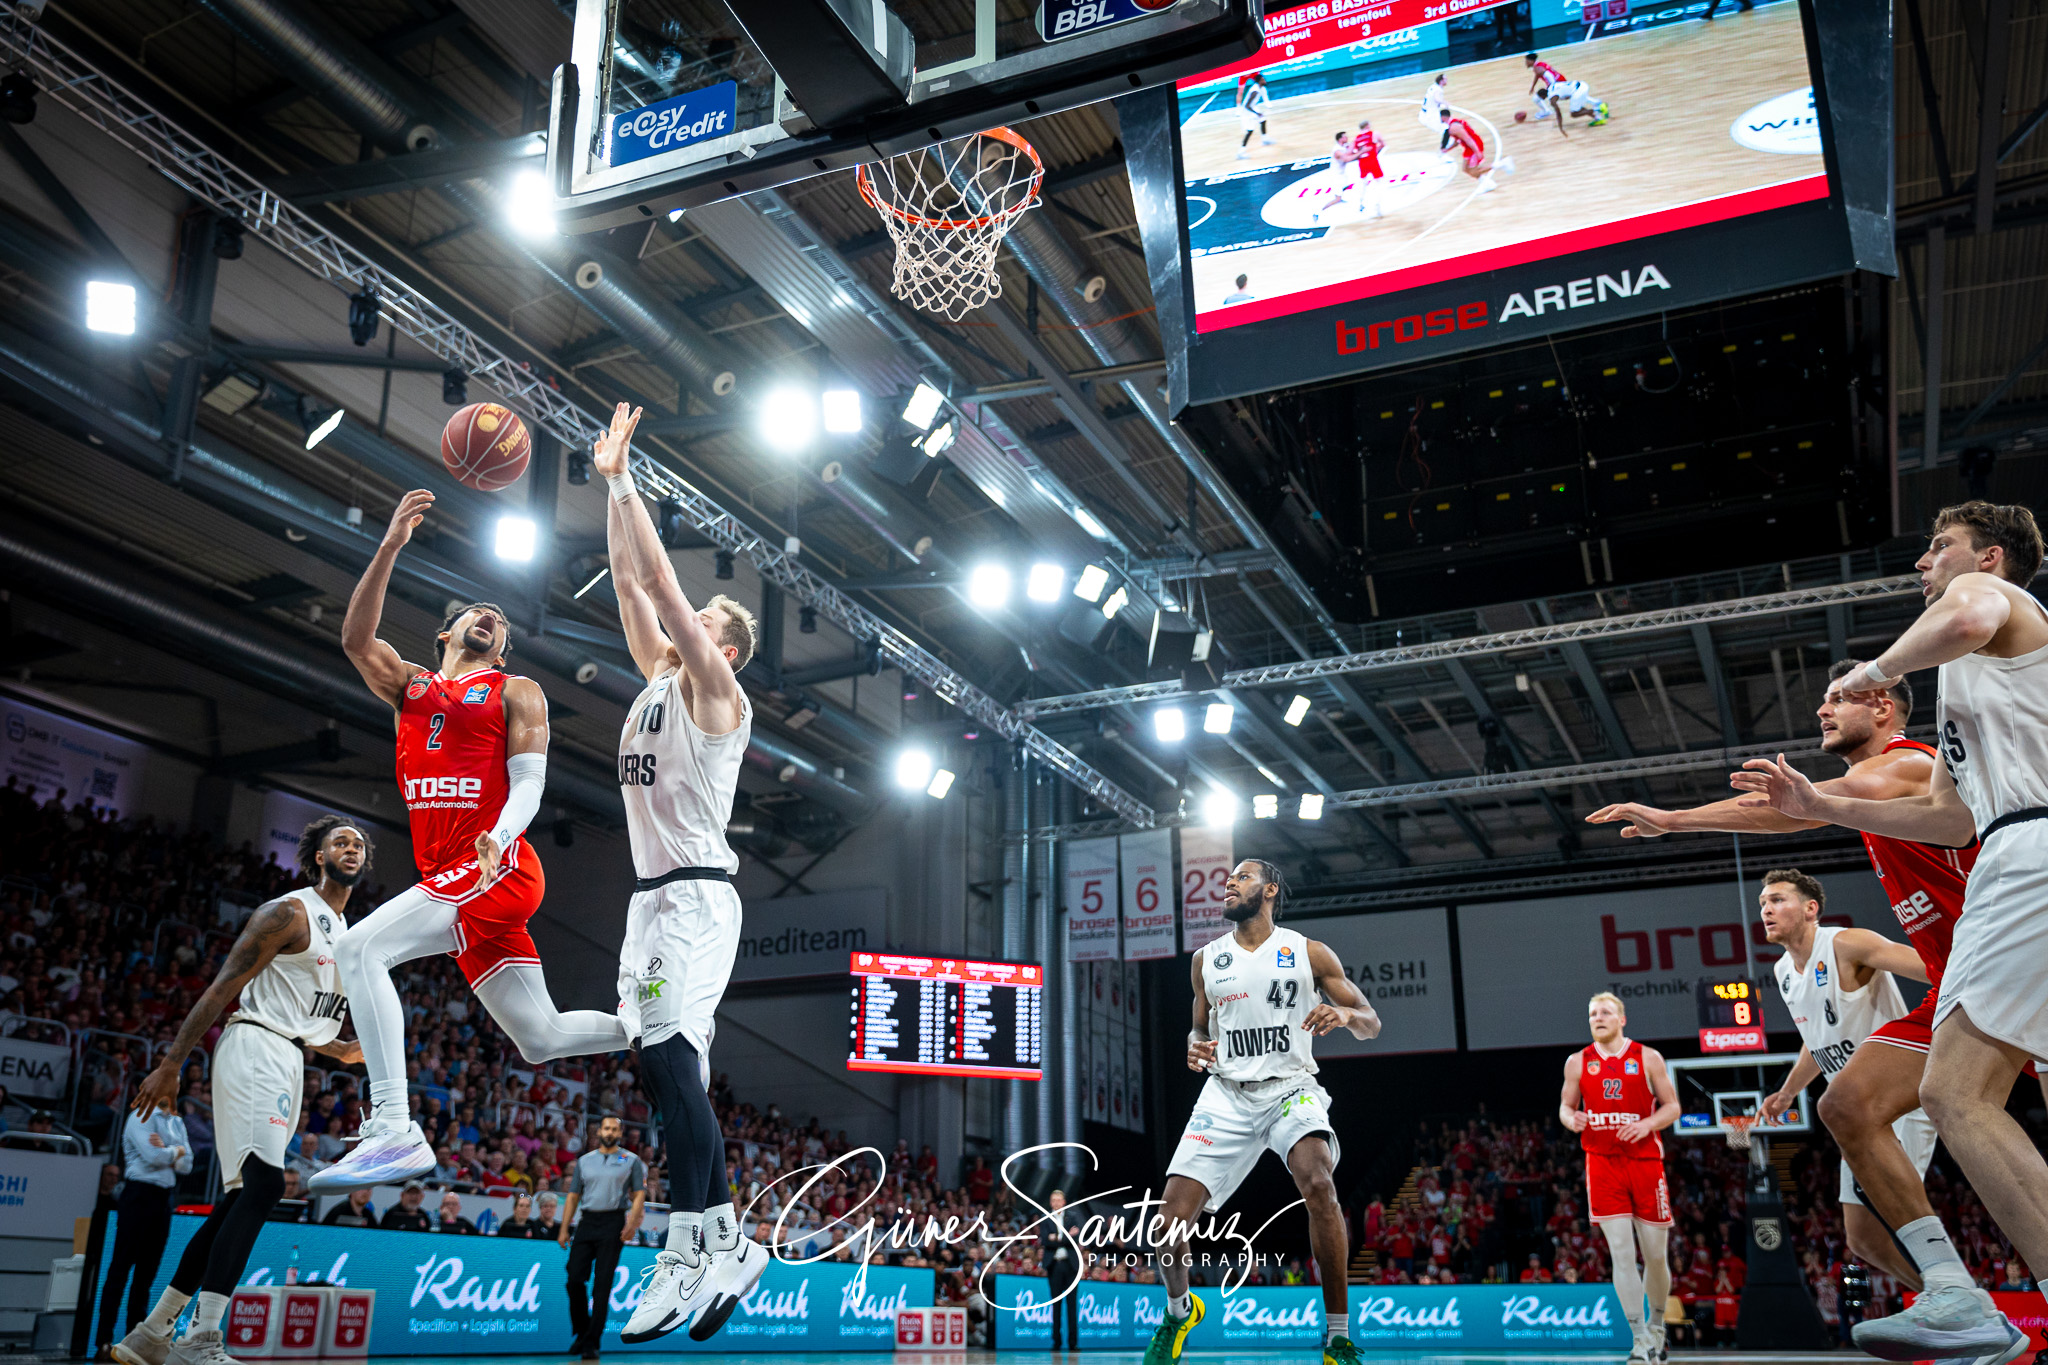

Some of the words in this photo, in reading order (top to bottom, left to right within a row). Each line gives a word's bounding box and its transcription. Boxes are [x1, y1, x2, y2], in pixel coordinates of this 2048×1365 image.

[1054, 2, 1114, 34] BBL
[1338, 6, 1392, 29] teamfoul
[1424, 2, 1447, 20] 3rd
[1267, 28, 1312, 49] timeout
[1362, 24, 1372, 37] 3
[1285, 44, 1295, 57] 0
[649, 109, 727, 149] Credit
[1335, 301, 1489, 356] brose
[1499, 264, 1672, 323] ARENA
[638, 701, 665, 735] 10
[426, 713, 445, 750] 2
[430, 801, 479, 810] Automobile
[1081, 879, 1103, 914] 5
[1136, 877, 1159, 913] 6
[1184, 866, 1231, 905] 23
[1069, 916, 1116, 930] brose
[1124, 913, 1173, 929] brose
[1124, 926, 1173, 939] bamberg
[740, 926, 867, 958] mediteam
[1070, 928, 1116, 940] baskets
[1222, 992, 1249, 1003] VEOLIA
[1266, 978, 1299, 1010] 42
[1376, 983, 1427, 999] GMBH
[1608, 978, 1690, 998] Technik
[1734, 1001, 1751, 1025] 8
[1824, 998, 1838, 1026] 8
[1704, 1030, 1759, 1049] tipico
[1602, 1078, 1623, 1100] 22
[1587, 1109, 1640, 1127] brose
[409, 1252, 541, 1313] Rauh
[1078, 1291, 1121, 1325] Rauh
[1222, 1296, 1321, 1327] Rauh
[1357, 1294, 1463, 1328] Rauh
[1501, 1293, 1614, 1328] Rauh
[409, 1318, 459, 1335] Spedition
[469, 1318, 506, 1336] Logistik
[506, 1318, 539, 1333] GmbH
